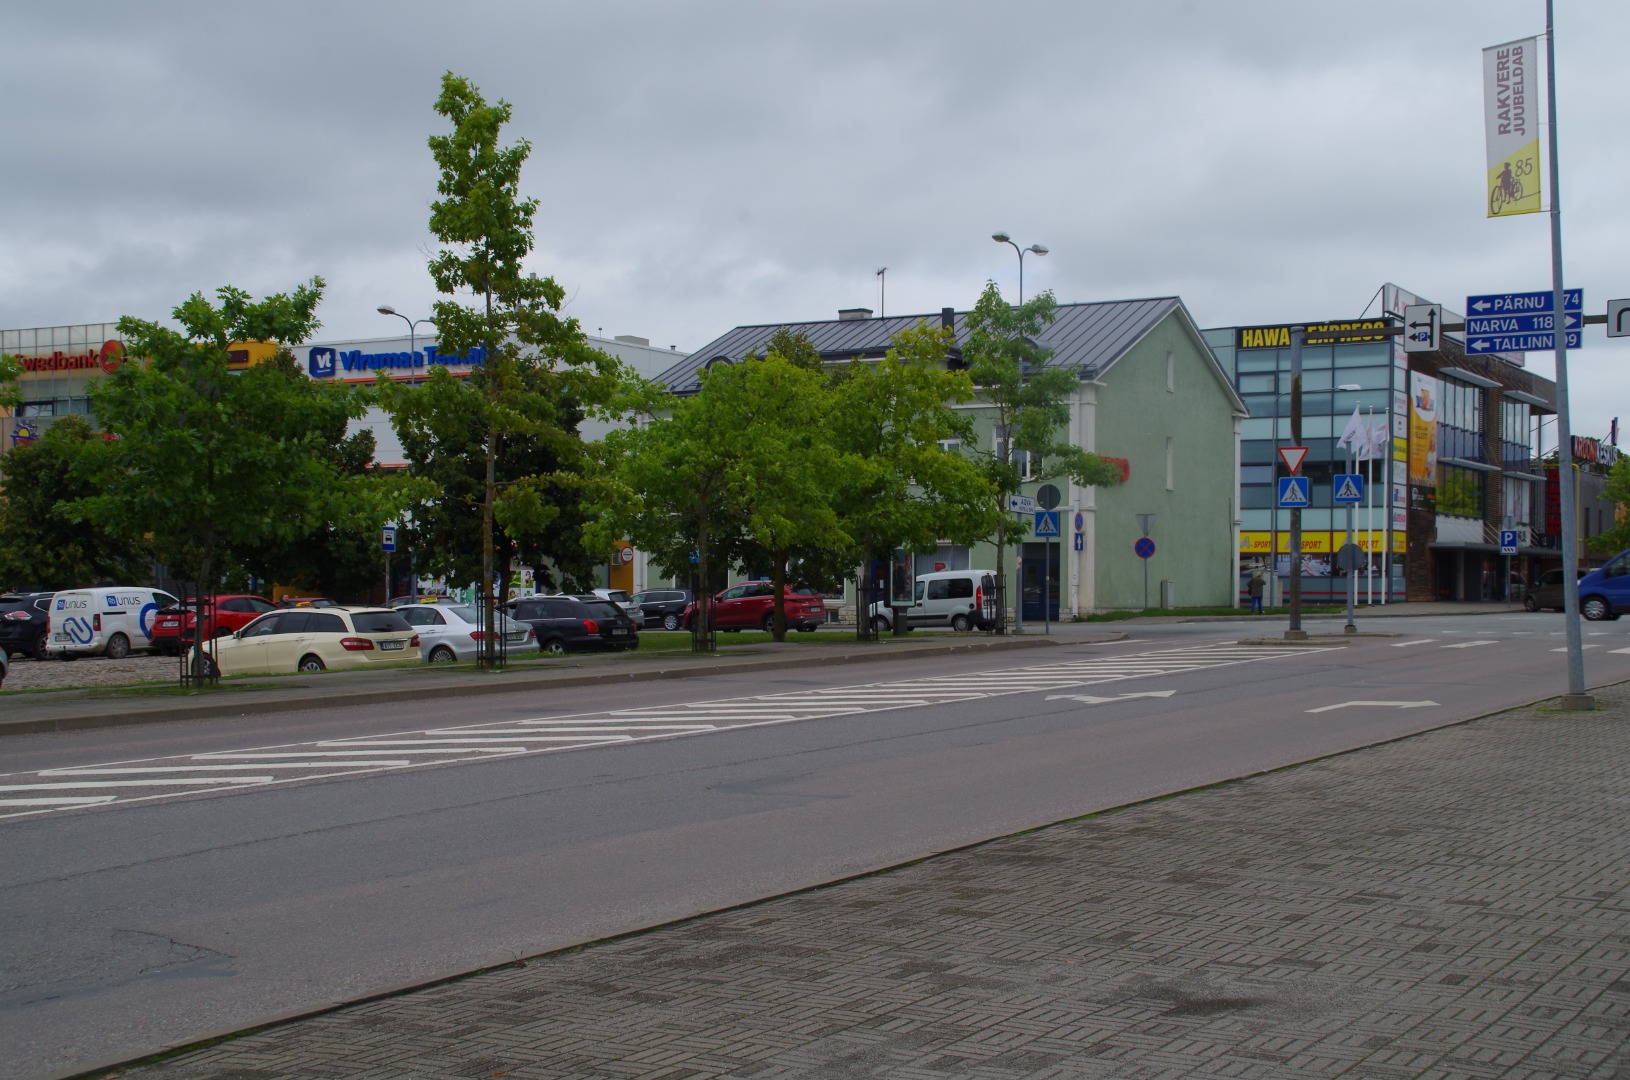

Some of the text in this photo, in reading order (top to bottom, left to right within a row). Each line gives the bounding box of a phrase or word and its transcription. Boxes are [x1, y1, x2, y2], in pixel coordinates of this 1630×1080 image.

[1496, 48, 1512, 136] RAKVERE
[1512, 45, 1525, 136] JUUBELDAB
[1515, 157, 1533, 178] 85
[1493, 295, 1545, 311] PÄRNU
[1469, 316, 1554, 333] NARVA 118
[1242, 321, 1385, 348] HAWA EXPRESS
[1493, 335, 1553, 350] TALLINN
[340, 350, 424, 371] Virumaa
[1253, 541, 1272, 549] SPORT
[1301, 540, 1323, 550] SPORT
[1504, 532, 1513, 545] P
